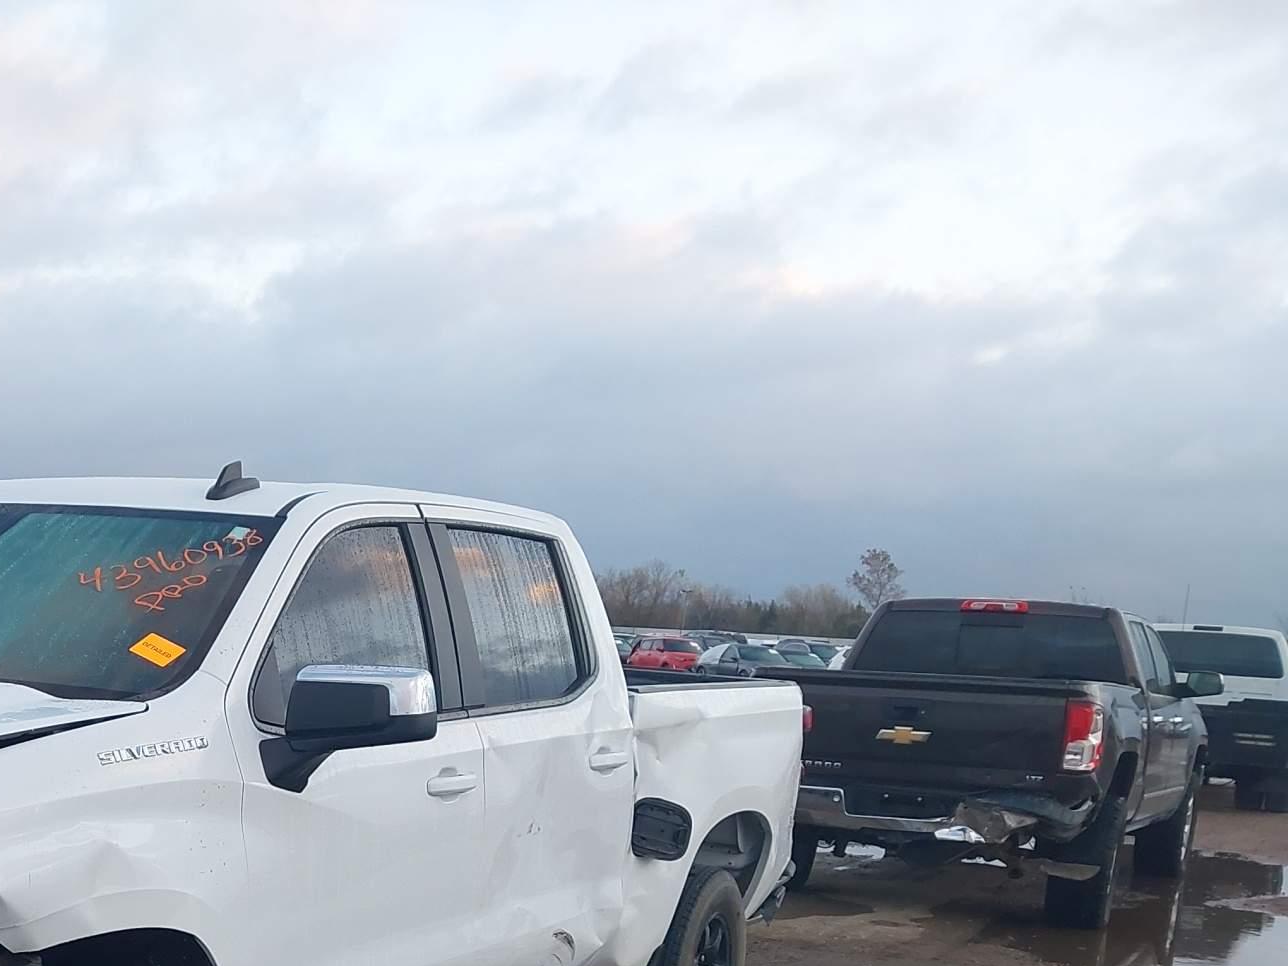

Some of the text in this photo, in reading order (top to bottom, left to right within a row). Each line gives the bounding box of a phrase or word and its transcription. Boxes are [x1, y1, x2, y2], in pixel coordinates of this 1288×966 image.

[78, 528, 263, 592] 43960938
[142, 641, 172, 659] DETAILED
[97, 736, 209, 766] SILVERADO
